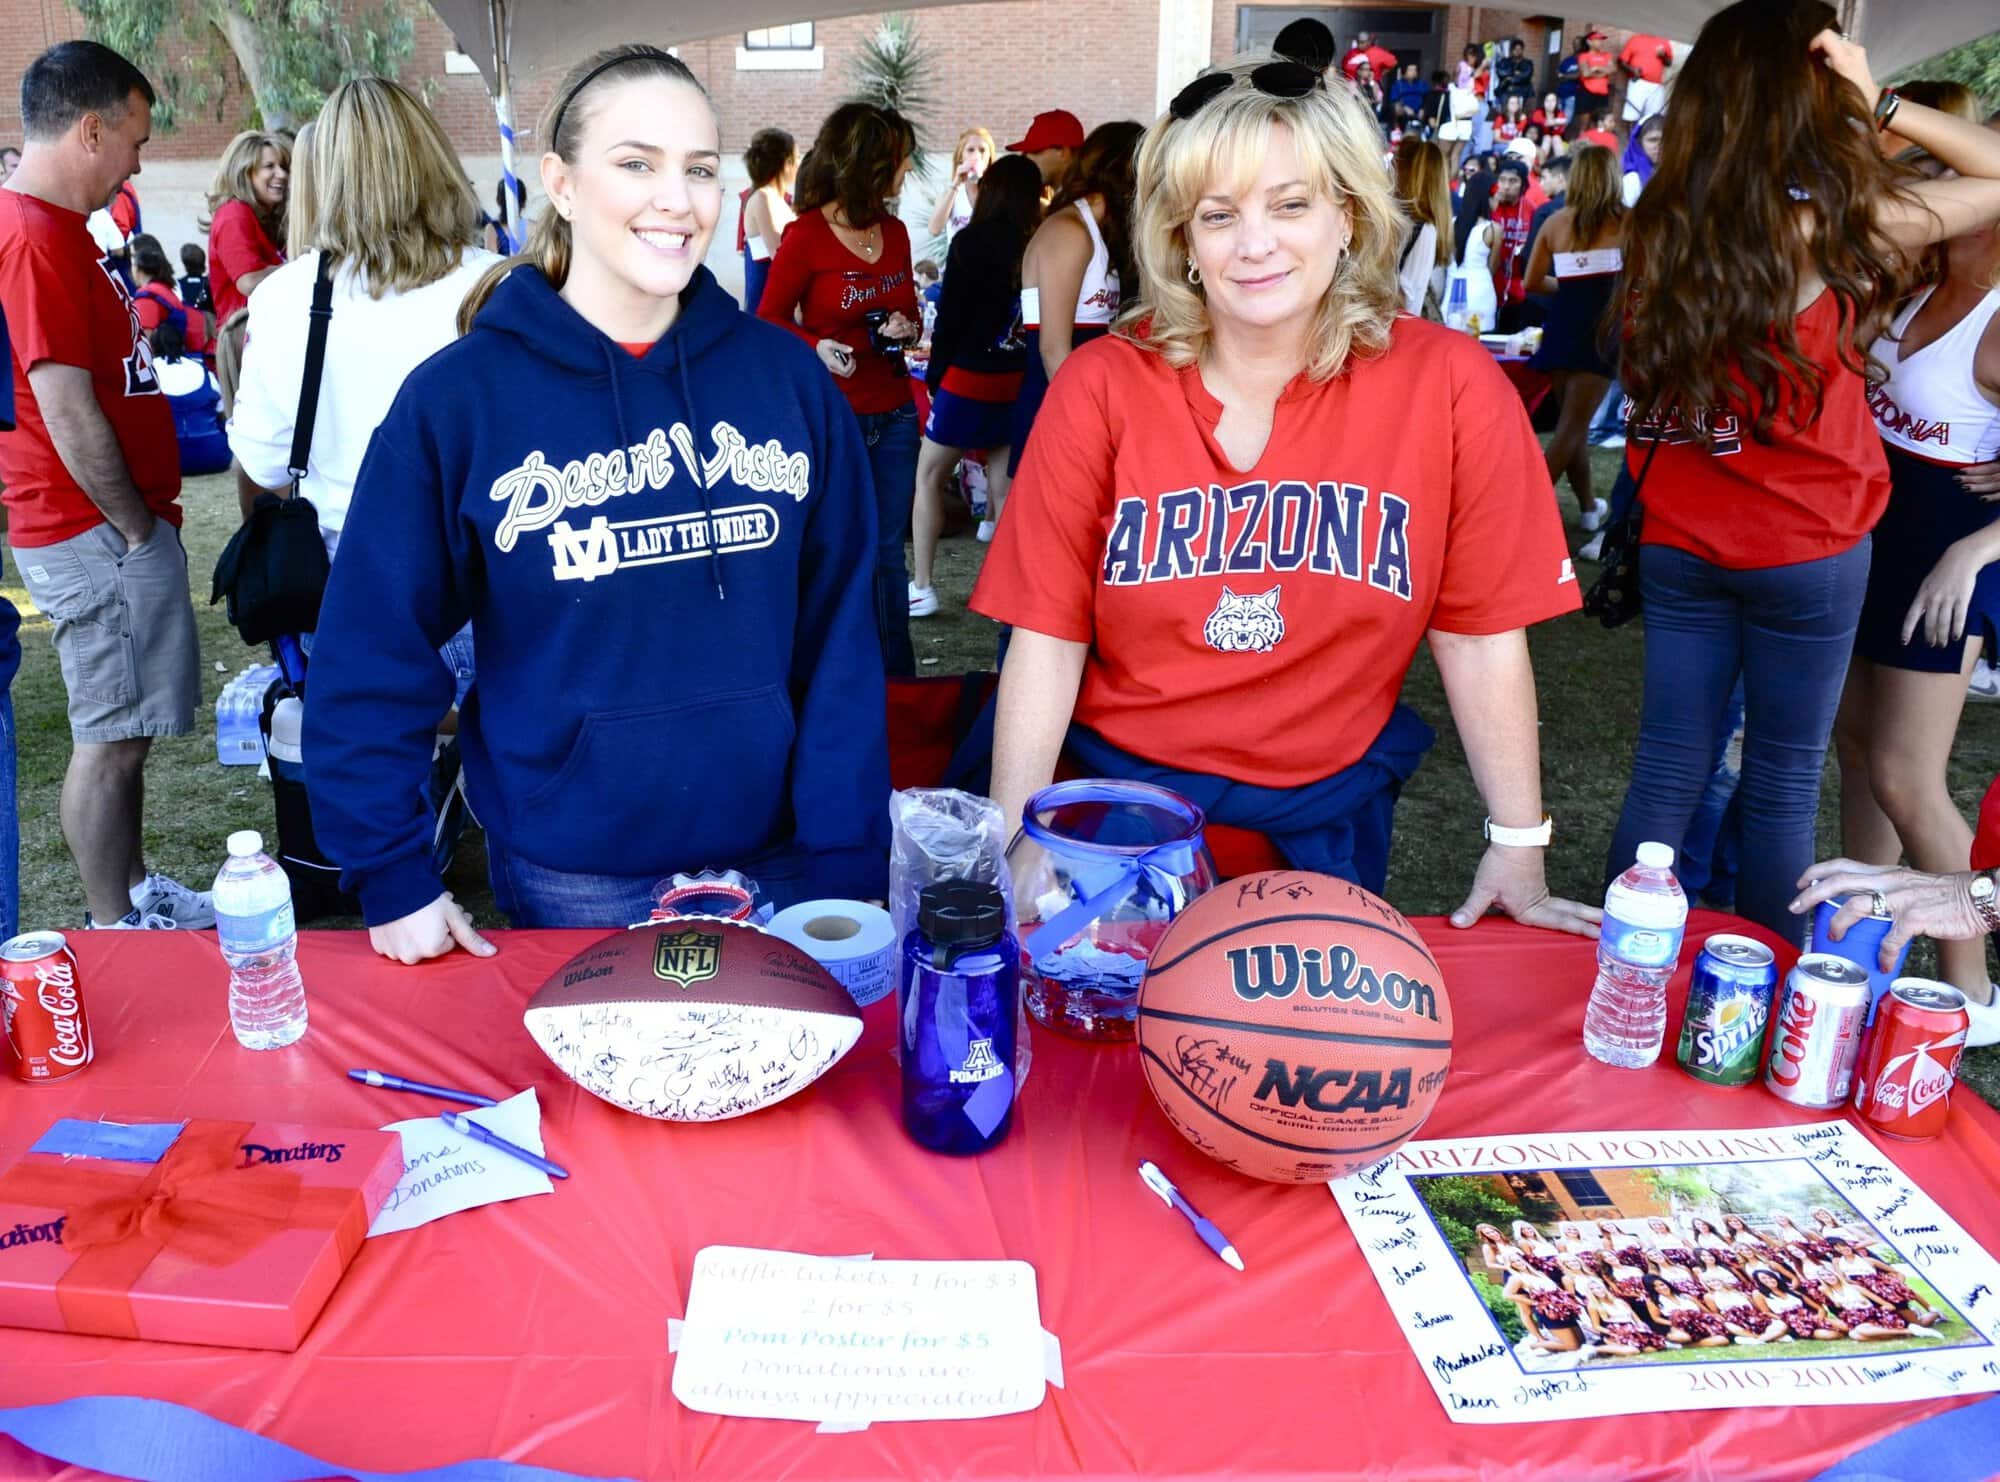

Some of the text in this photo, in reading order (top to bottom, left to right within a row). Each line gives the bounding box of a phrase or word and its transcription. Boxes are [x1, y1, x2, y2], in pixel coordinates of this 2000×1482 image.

[490, 421, 810, 552] Desert Vista
[621, 526, 673, 558] LADY
[1103, 480, 1412, 601] ARIZONA
[663, 946, 711, 972] NFL
[563, 966, 614, 987] Wilson
[1226, 943, 1440, 1022] Wilson
[34, 961, 88, 1067] Coca-Cola
[1292, 1004, 1348, 1015] SOLUTION
[1696, 1002, 1768, 1067] Sprite
[1770, 991, 1816, 1087] Coke
[949, 1062, 1004, 1083] POMLINE
[1253, 1058, 1412, 1114] NCAA
[1249, 1102, 1319, 1123] OFFICIAL
[1323, 1117, 1367, 1125] GAME
[236, 1142, 345, 1169] Donations
[1395, 1140, 1592, 1170] ARIZONA
[1599, 1135, 1795, 1161] POMLINE
[381, 1159, 486, 1211] Donations
[699, 1262, 785, 1283] Raffle
[931, 1270, 974, 1291] for
[984, 1271, 1018, 1290] $3
[826, 1297, 867, 1318] for
[882, 1299, 914, 1316] $5
[722, 1328, 993, 1351] Pom Poster for $5
[740, 1358, 974, 1379] Donations are
[1680, 1365, 1865, 1391] 2010-2011
[689, 1382, 800, 1406] always
